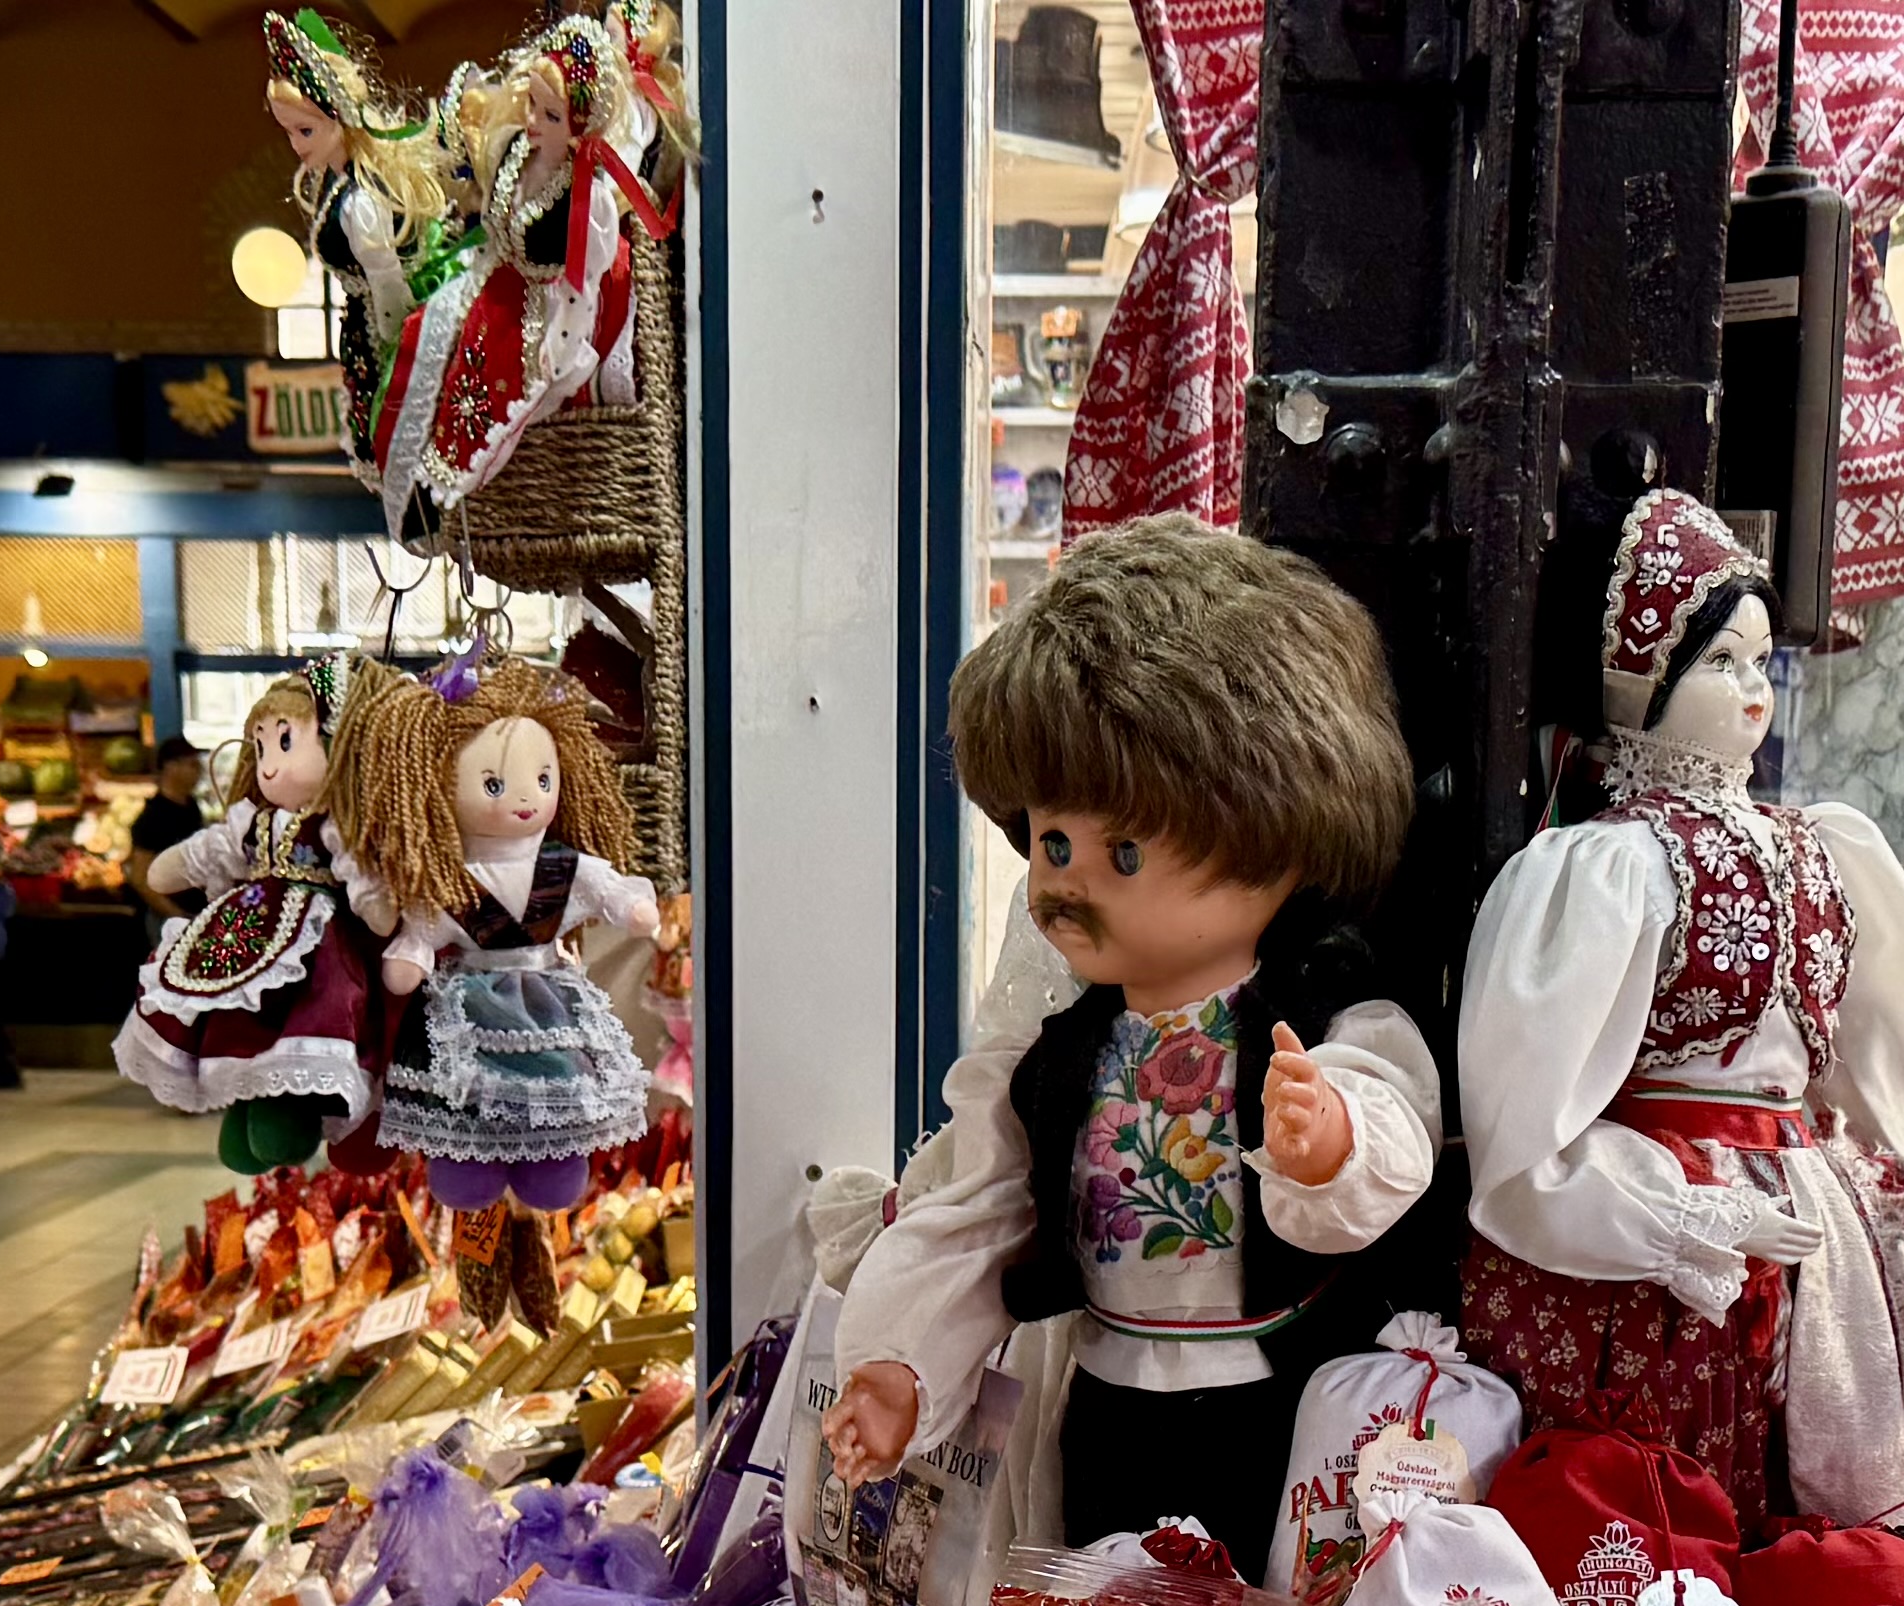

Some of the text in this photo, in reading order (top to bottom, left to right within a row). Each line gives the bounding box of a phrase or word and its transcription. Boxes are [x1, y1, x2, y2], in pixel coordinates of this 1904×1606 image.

[807, 1378, 839, 1413] WIT
[946, 1447, 989, 1489] BOX
[1583, 1557, 1649, 1574] HUNGARY
